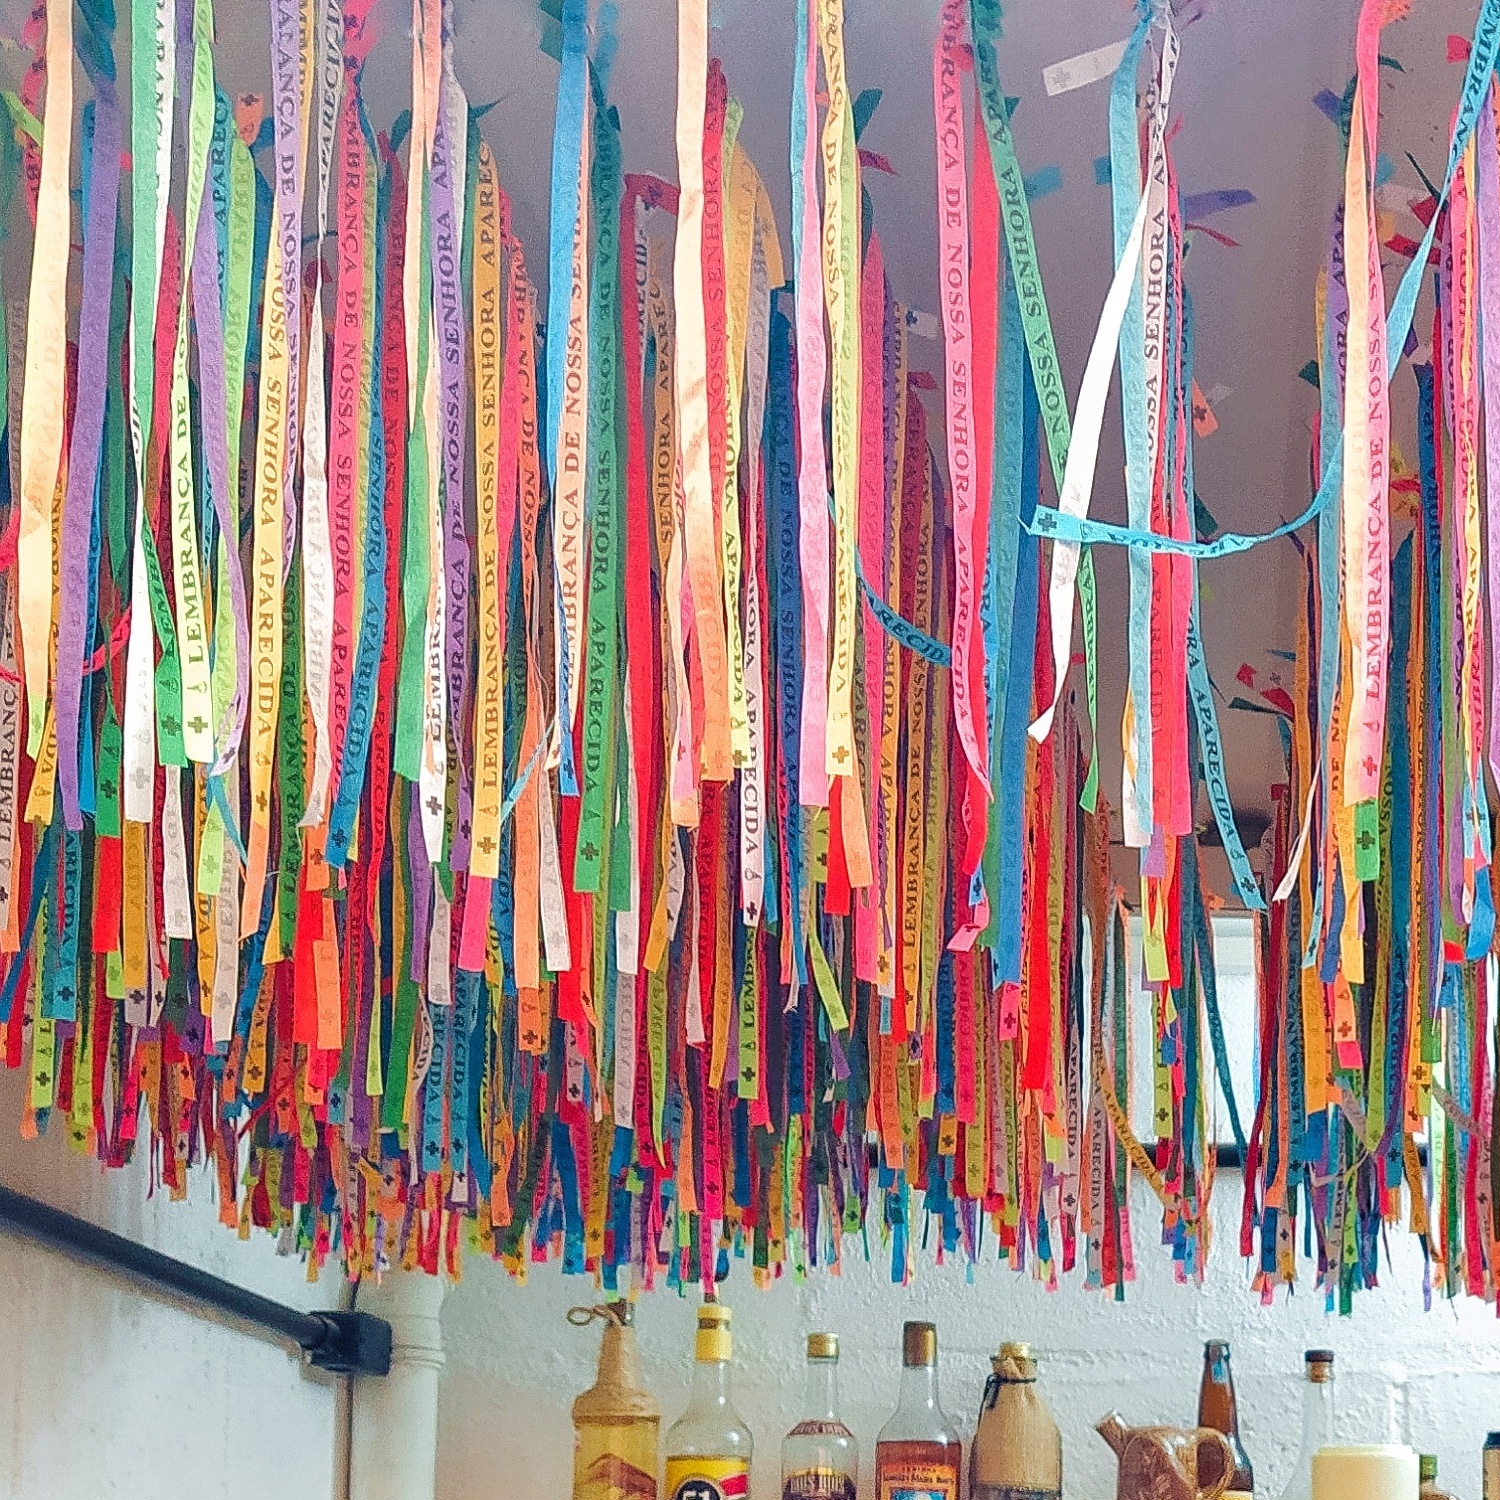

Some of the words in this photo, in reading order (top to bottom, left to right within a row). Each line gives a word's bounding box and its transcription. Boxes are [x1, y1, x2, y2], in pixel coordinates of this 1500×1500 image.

[278, 152, 296, 196] DE
[825, 142, 838, 186] DE
[944, 188, 962, 229] DE
[282, 212, 298, 316] NOSSA
[437, 209, 461, 364] SENHORA
[599, 281, 611, 320] DE
[827, 202, 841, 306] NOSSA
[947, 244, 966, 345] NOSSA
[999, 166, 1042, 318] SENHORA
[1144, 206, 1166, 360] SENHORA
[342, 289, 358, 328] DE
[479, 288, 497, 427] SENHORA
[565, 316, 583, 416] NOSSA
[177, 396, 188, 444] DE
[336, 341, 358, 438] NOSSA
[598, 334, 612, 433] NOSSA
[1369, 319, 1384, 423] NOSSA
[261, 377, 284, 526] SENHORA
[447, 380, 463, 485] NOSSA
[482, 442, 497, 536] NOSSA
[565, 433, 580, 474] DE
[952, 359, 970, 514] SENHORA
[1370, 438, 1384, 479] DE
[178, 452, 205, 664] LEMBRANÇA
[333, 457, 353, 597] SENHORA
[485, 550, 496, 586] DE
[593, 449, 611, 594] SENHORA
[258, 547, 277, 741] APARECIDA
[955, 533, 974, 721] APARECIDA
[1366, 492, 1382, 699] LEMBRANÇA
[344, 596, 380, 780] APARECIDA
[482, 600, 501, 787] LEMBRANÇA
[585, 619, 607, 794] APARECIDA
[743, 689, 760, 854] APARECIDA
[1194, 688, 1236, 840] APARECIDA
[905, 796, 921, 948] LEMBRANÇA
